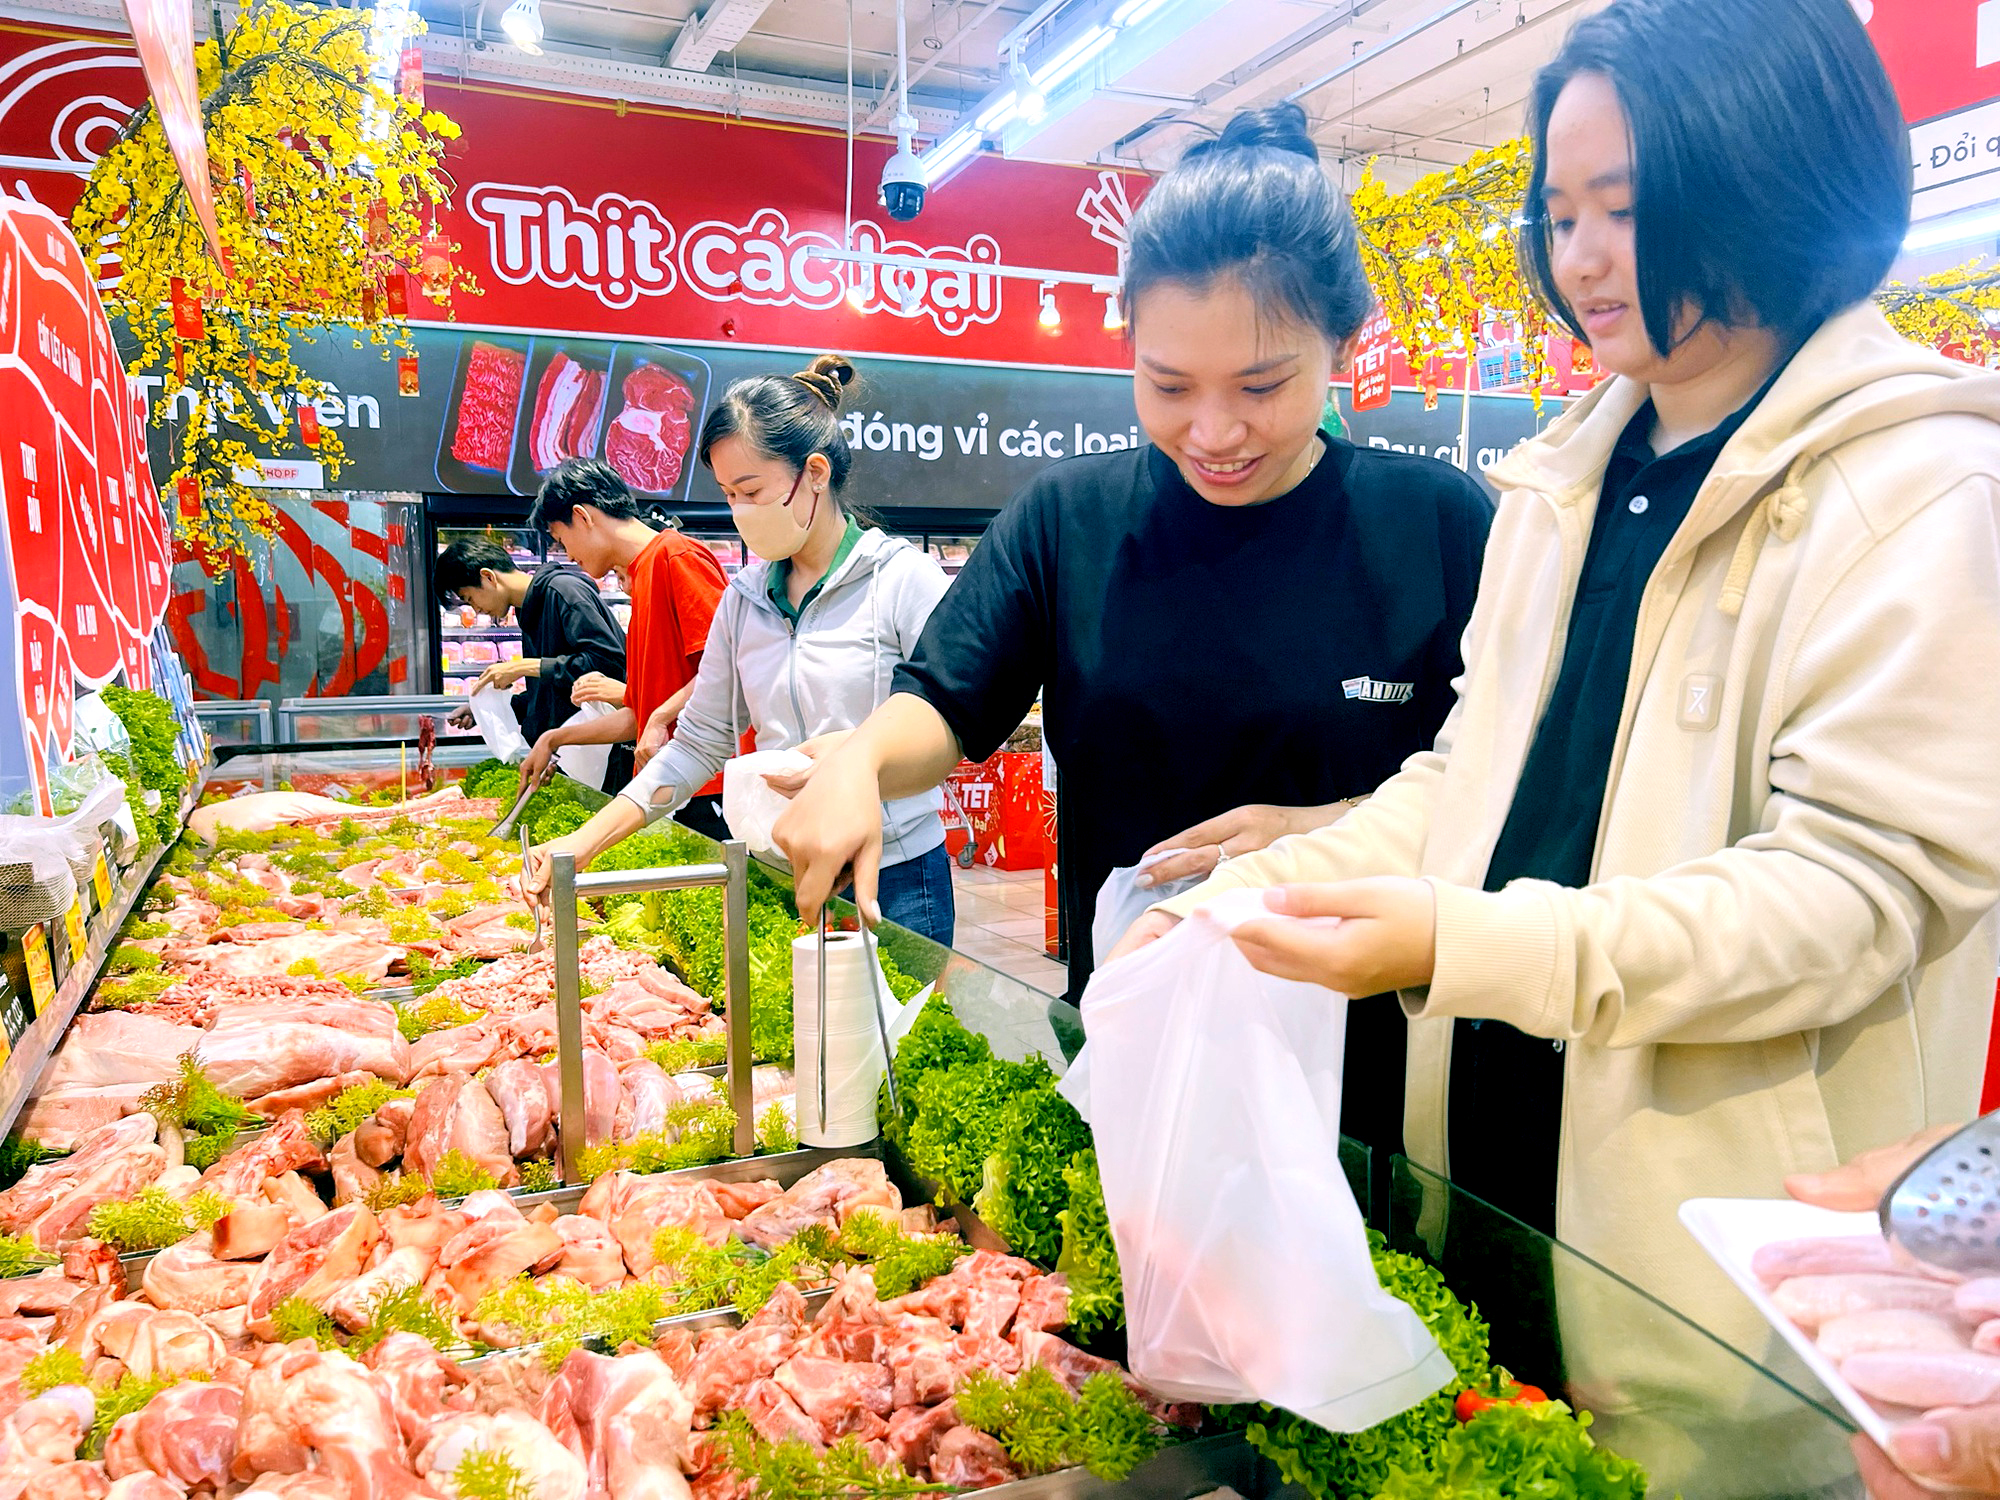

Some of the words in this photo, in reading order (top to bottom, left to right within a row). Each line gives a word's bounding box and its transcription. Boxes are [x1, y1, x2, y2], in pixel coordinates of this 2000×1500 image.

[1930, 132, 1976, 169] Đổi
[480, 195, 665, 295] Thịt
[691, 222, 834, 297] các
[858, 231, 992, 324] loại
[1355, 338, 1388, 377] TẾT
[839, 411, 943, 461] đóng
[954, 412, 990, 455] vỉ
[998, 419, 1065, 459] các
[962, 772, 994, 809] TẾT
